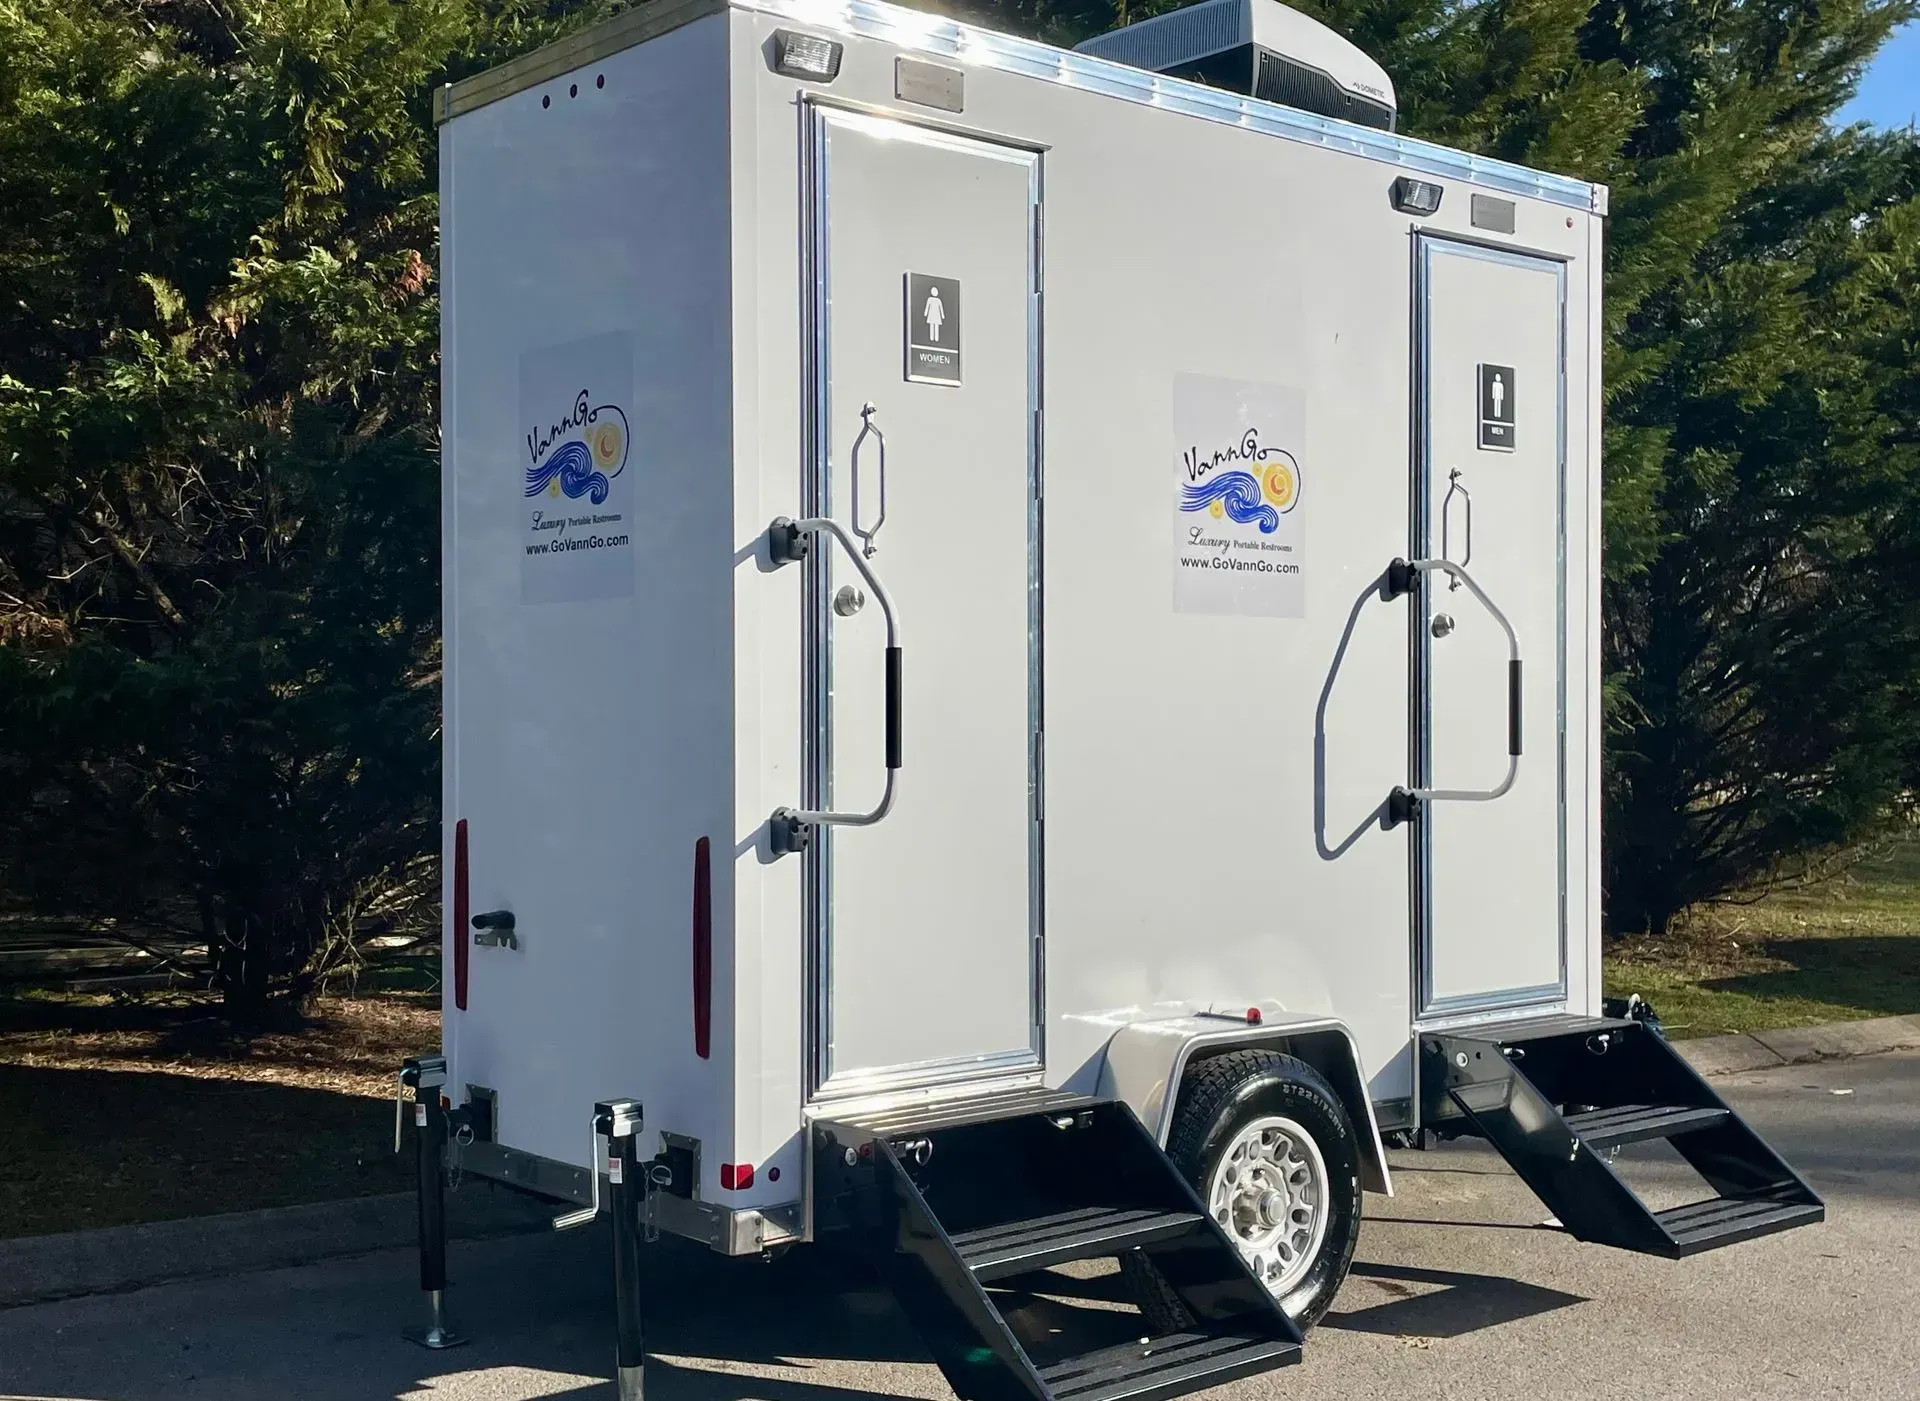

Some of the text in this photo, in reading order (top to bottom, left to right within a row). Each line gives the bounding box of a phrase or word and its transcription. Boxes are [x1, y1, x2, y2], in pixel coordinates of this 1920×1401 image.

[1360, 84, 1385, 97] DOMETIC
[920, 353, 950, 365] WOMEN
[527, 388, 598, 464] VannGo
[1184, 428, 1268, 481] VannGo
[532, 511, 622, 535] Luxury Portable Restrooms
[526, 533, 629, 555] www.GoVannGo.com
[1188, 526, 1292, 554] Luxury Portable Restrooms
[1181, 557, 1299, 575] www.GoVannGo.com
